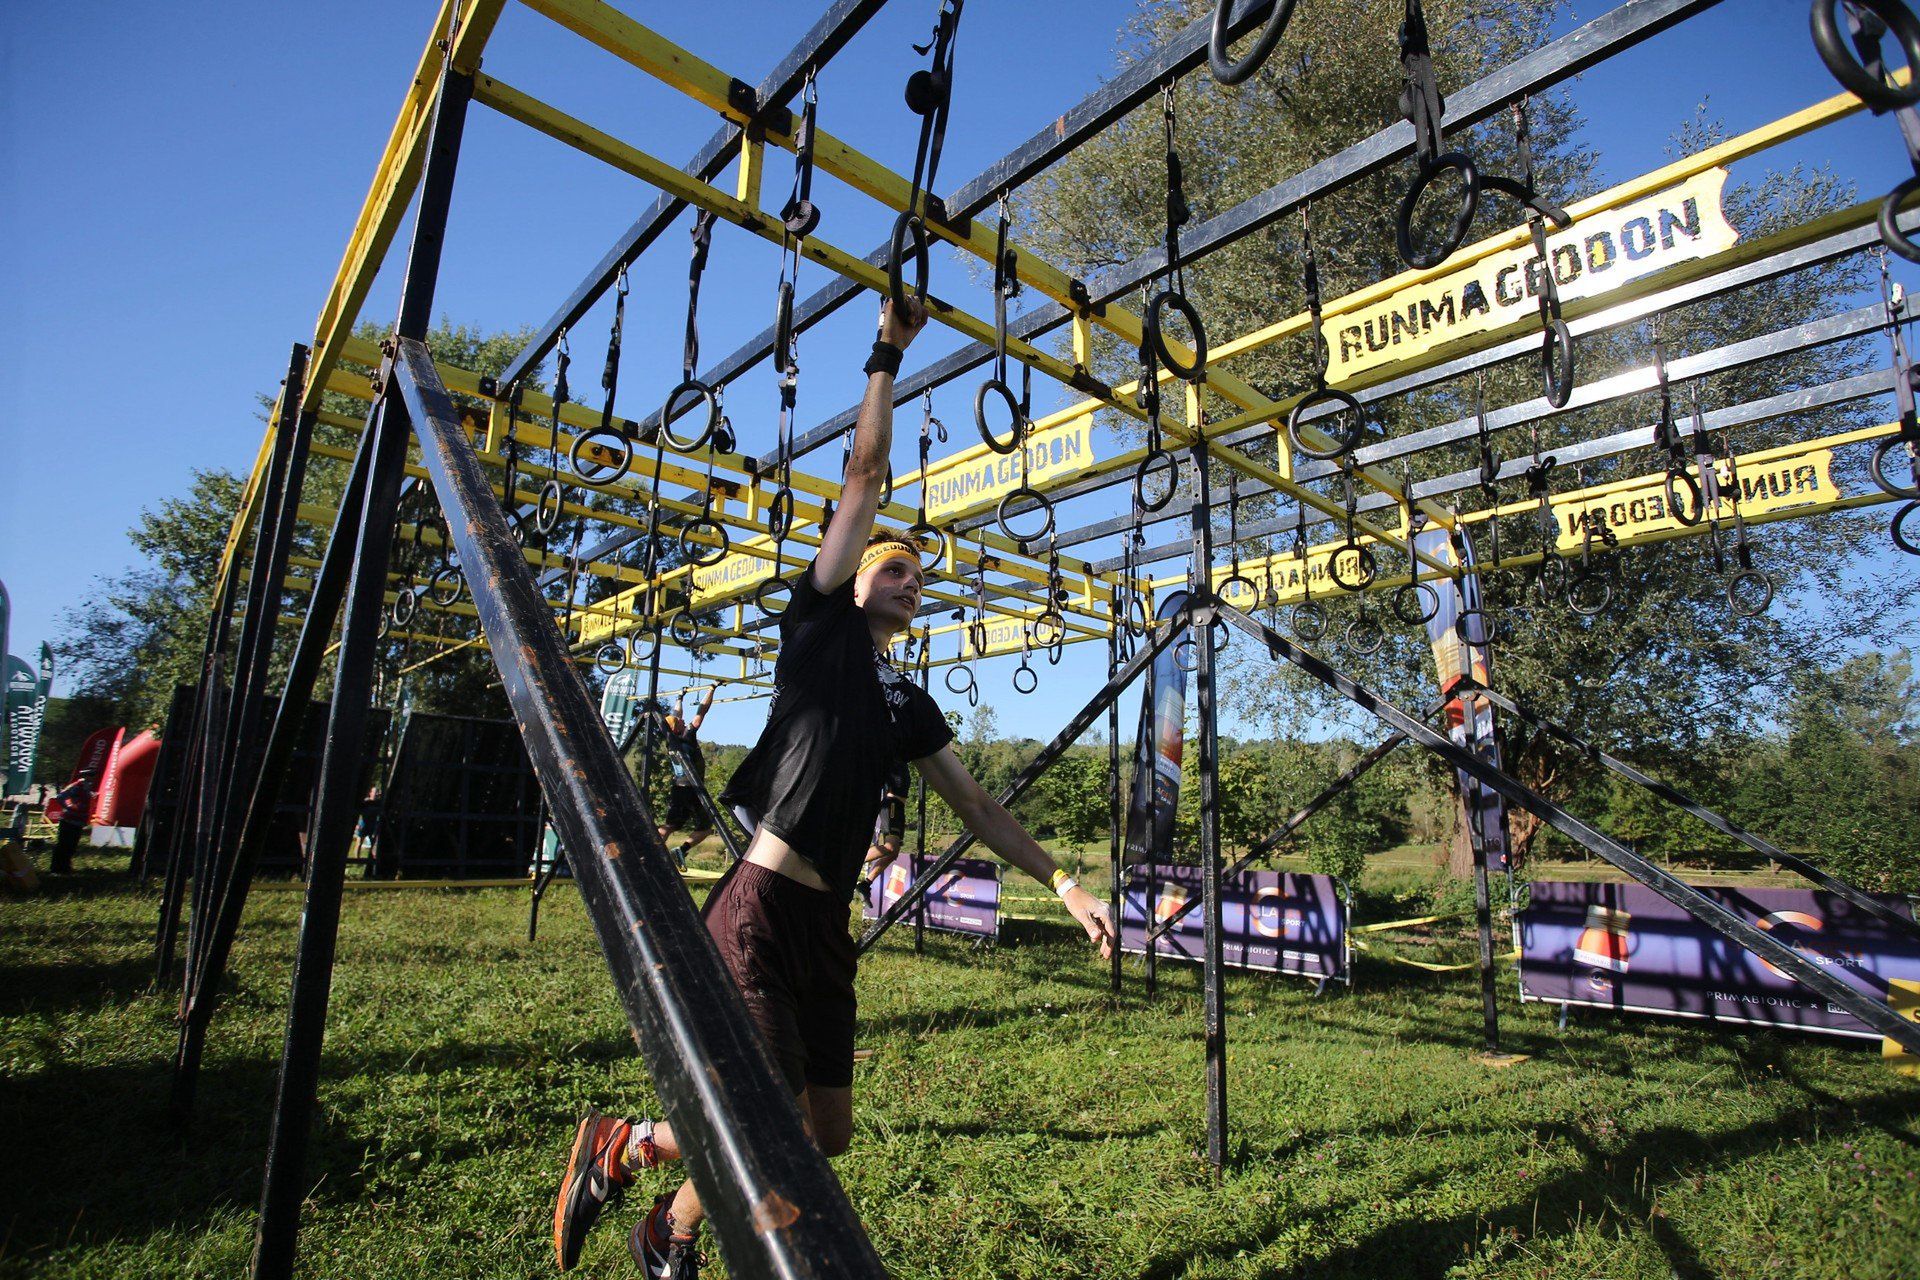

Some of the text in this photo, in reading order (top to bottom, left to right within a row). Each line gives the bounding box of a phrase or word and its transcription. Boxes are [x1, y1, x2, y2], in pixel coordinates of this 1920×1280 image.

[1339, 197, 1702, 364] RUNMAGEDDON
[928, 430, 1082, 510] RUNMAGEDDON
[1815, 956, 1864, 968] SPORT
[1706, 990, 1801, 1009] PRIMABIOTIC
